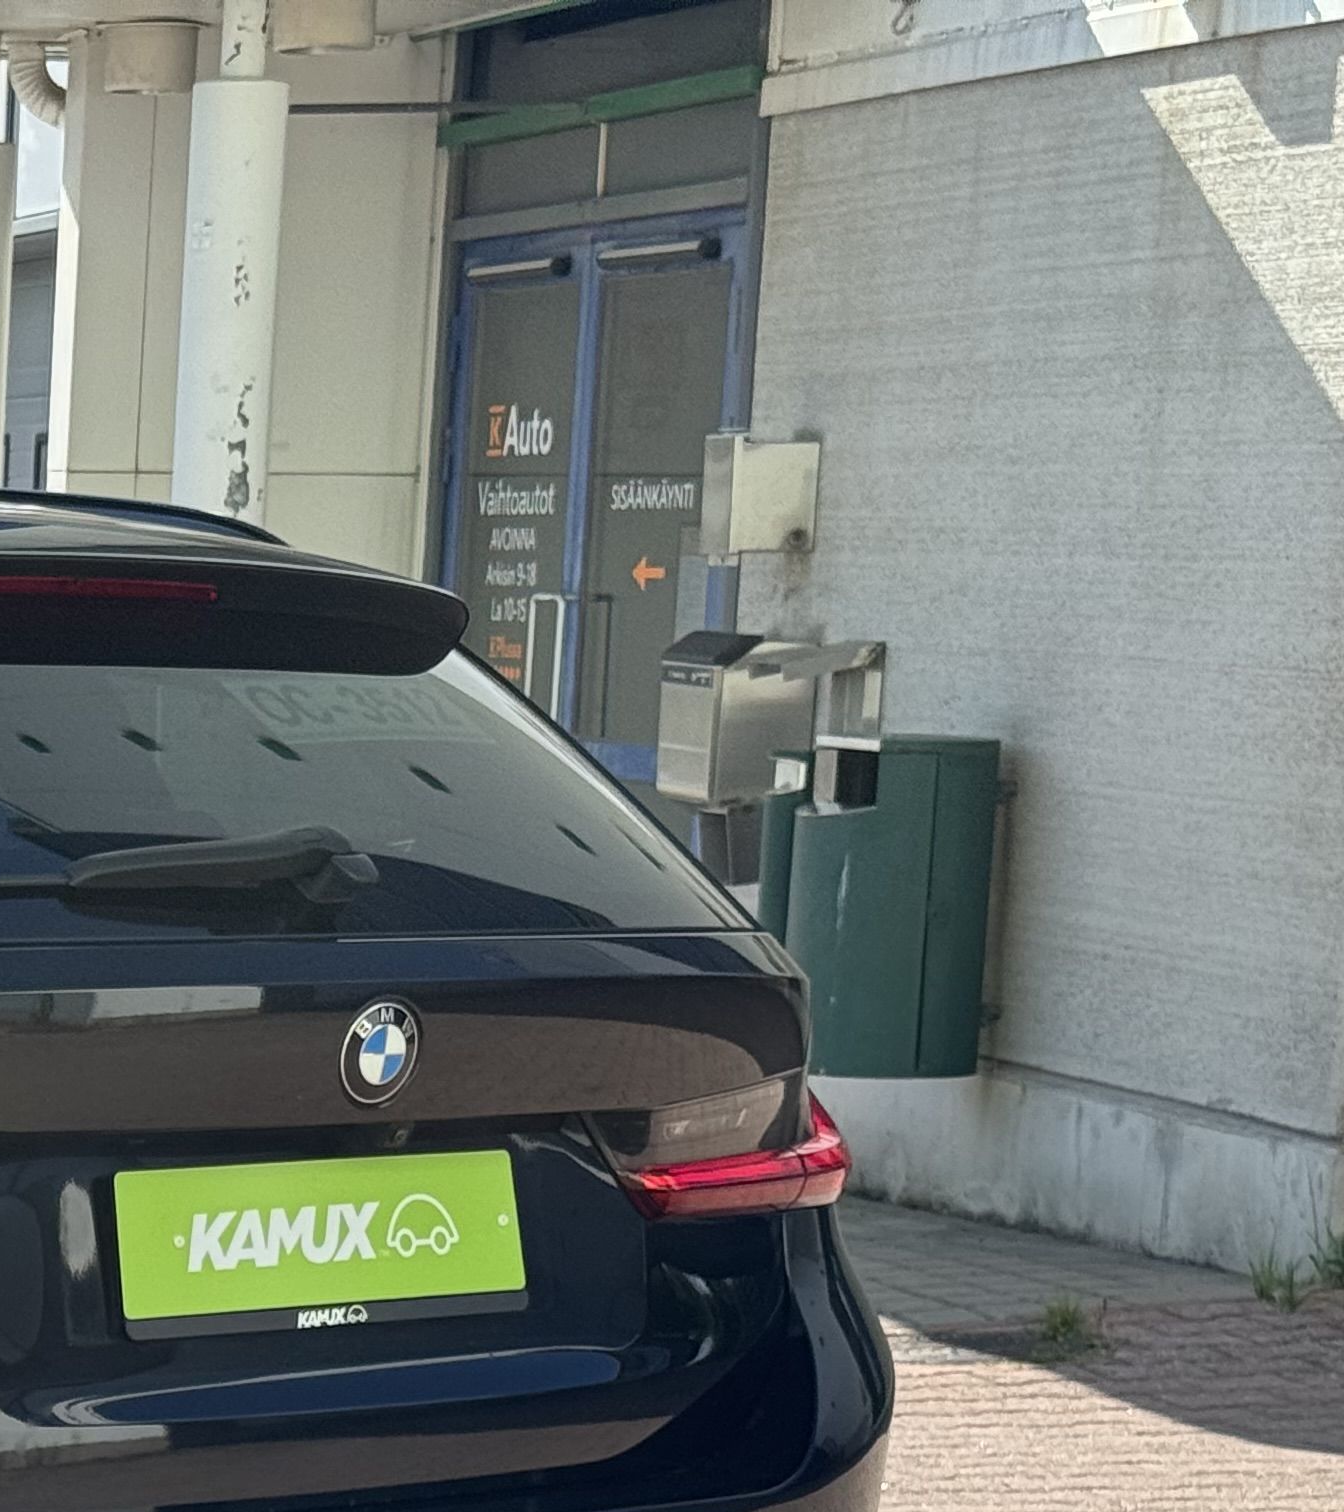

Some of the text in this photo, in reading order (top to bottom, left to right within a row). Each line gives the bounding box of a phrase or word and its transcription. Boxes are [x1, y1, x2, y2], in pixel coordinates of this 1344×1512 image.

[478, 480, 555, 516] Vaihtoautot
[610, 479, 694, 510] SISÄÄNKÄYNTI
[488, 526, 536, 551] AVOINNA
[187, 1201, 380, 1273] KAMUX
[297, 1305, 348, 1329] KAMUX
